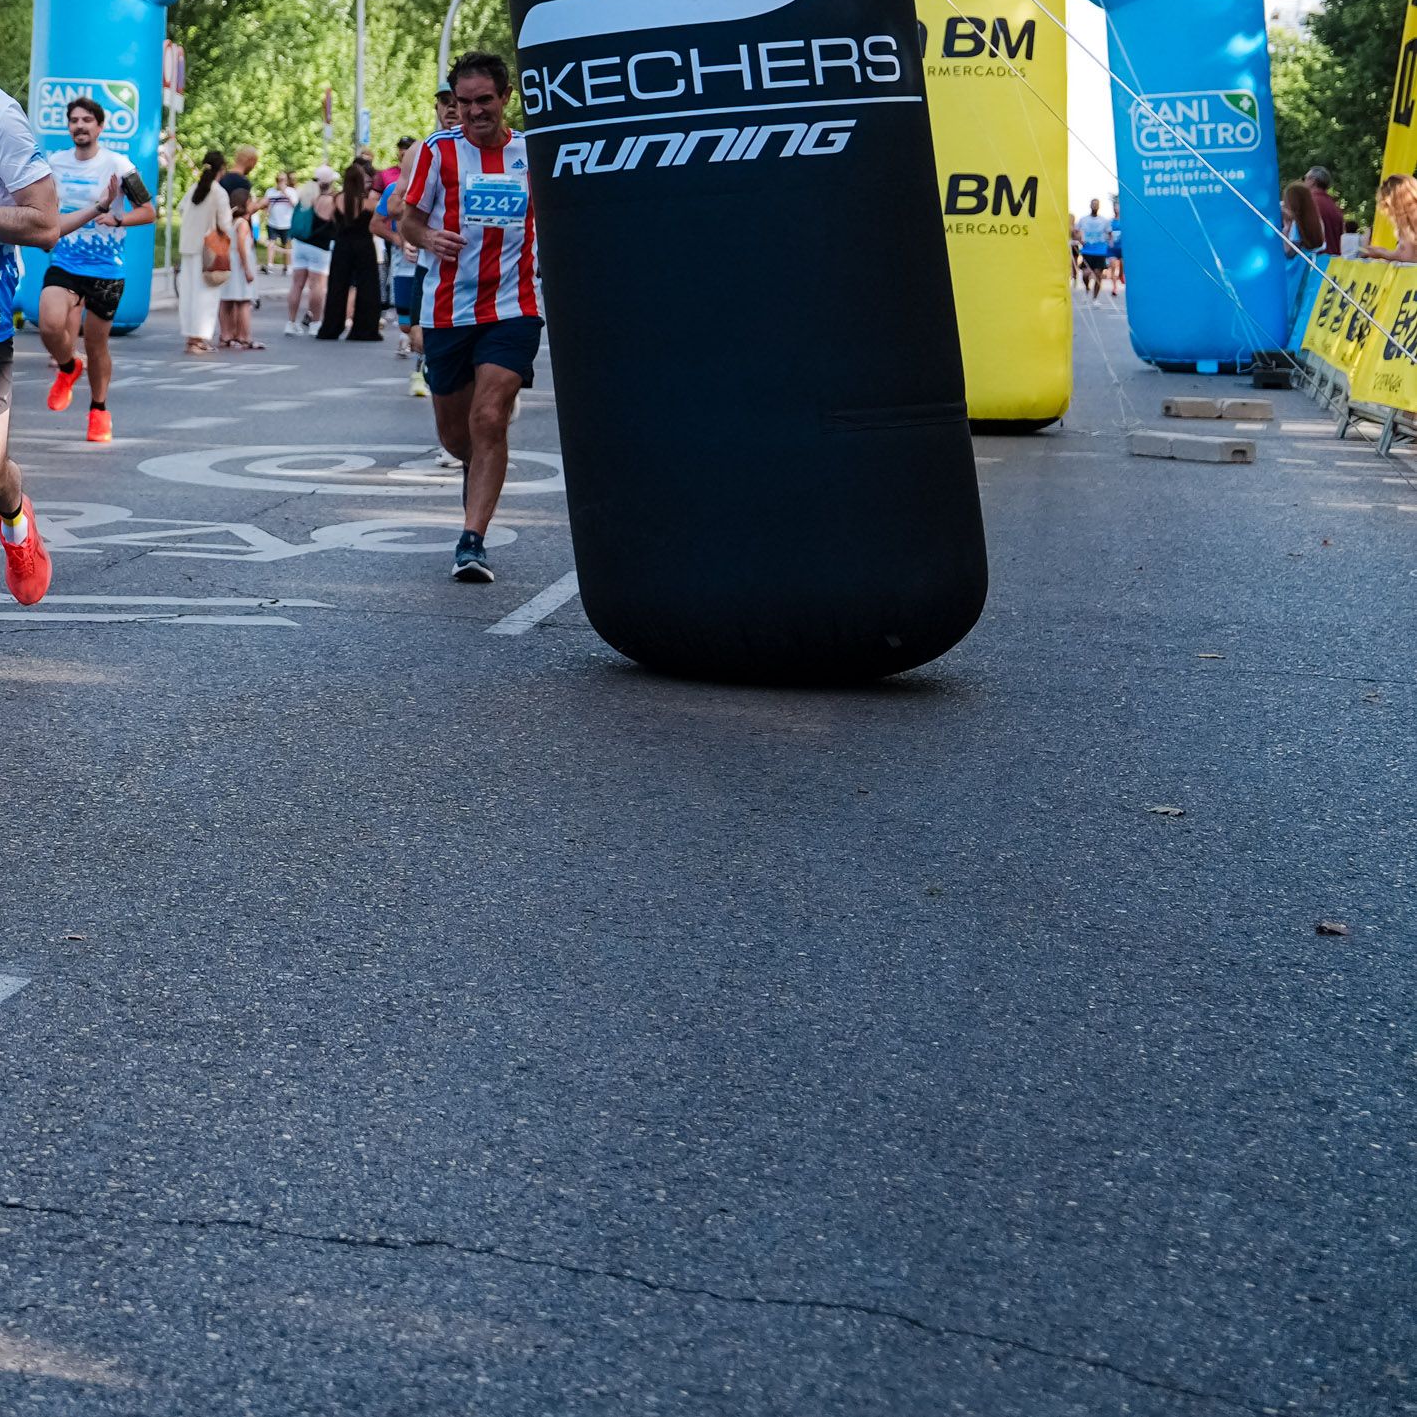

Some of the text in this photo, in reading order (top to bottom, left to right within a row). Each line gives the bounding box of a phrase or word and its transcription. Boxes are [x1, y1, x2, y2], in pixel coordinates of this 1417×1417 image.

[941, 17, 1036, 61] BM
[521, 35, 900, 115] SKECHERS
[927, 65, 1026, 78] RMERCADOS
[39, 106, 132, 131] CERO
[1136, 98, 1209, 125] SANI
[1139, 121, 1255, 150] CENTRO
[552, 119, 857, 179] RUNNING
[1142, 158, 1205, 171] Limpieza
[470, 194, 524, 212] 2247
[944, 174, 1039, 218] BM
[1145, 184, 1223, 196] inteligente
[945, 222, 1030, 236] MERCADOS
